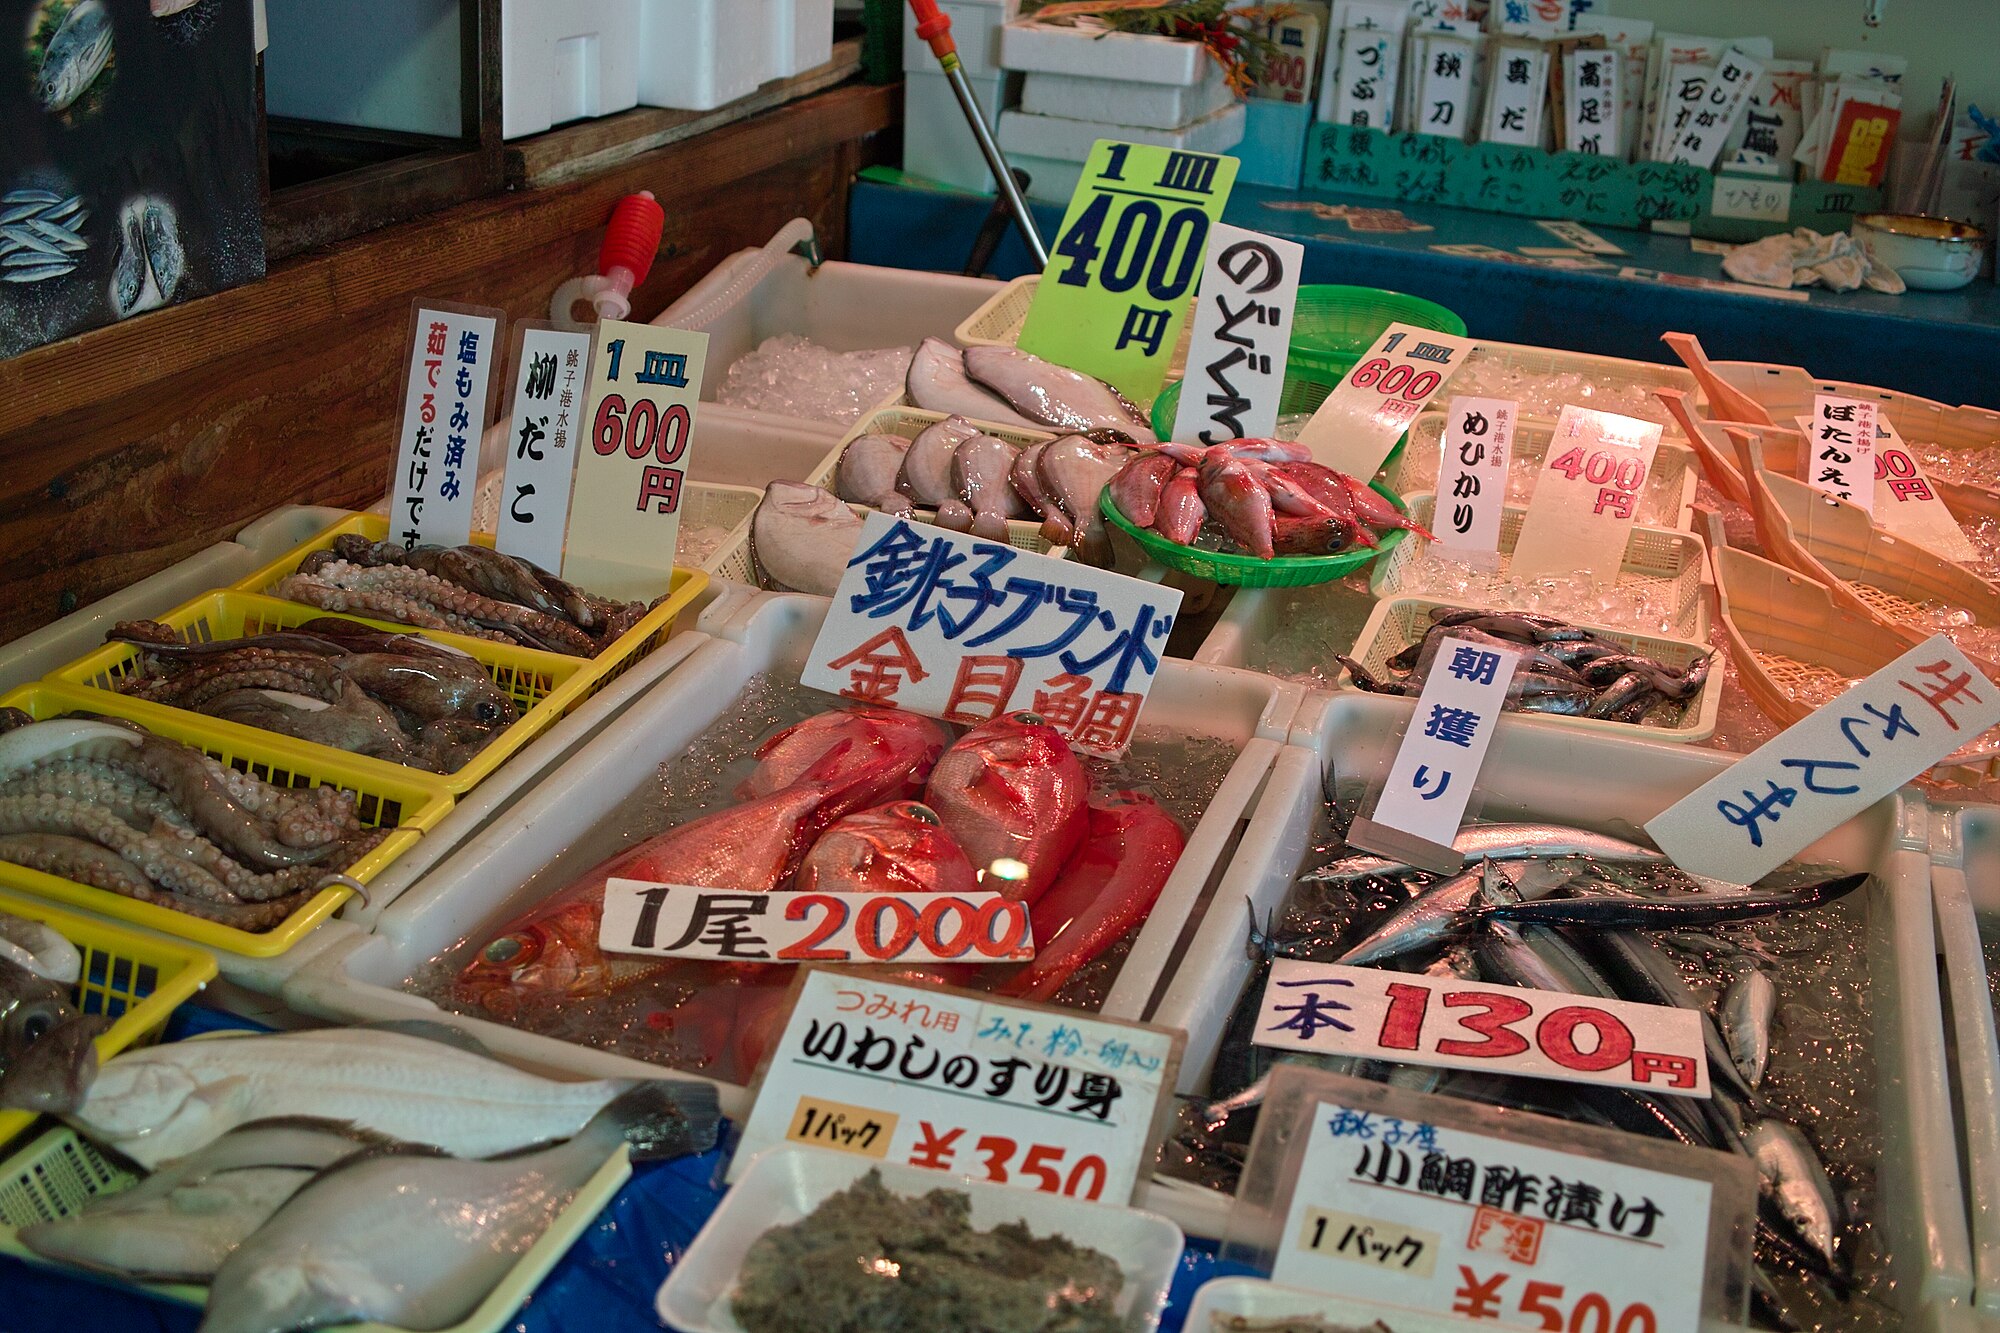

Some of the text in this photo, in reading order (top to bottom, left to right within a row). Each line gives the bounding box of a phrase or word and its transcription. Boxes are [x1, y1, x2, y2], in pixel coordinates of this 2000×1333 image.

[1097, 143, 1219, 195] 1皿
[1056, 194, 1209, 302] 400
[1115, 304, 1173, 358] 円
[1381, 332, 1455, 364] 1皿
[606, 338, 690, 388] 1皿
[1350, 357, 1442, 401] 600
[440, 330, 480, 502] 塩もみ済み
[554, 349, 579, 449] 銚子港水揚
[510, 351, 558, 524] 柳だこ
[591, 393, 691, 464] 600
[636, 465, 684, 514] 円
[1452, 411, 1489, 534] めひかり
[1550, 446, 1647, 491] 400
[1887, 477, 1934, 502] 円
[1594, 487, 1638, 519] 円
[847, 519, 1173, 695] 銚子ブランド
[827, 624, 1144, 752] 金目鯛
[1413, 645, 1502, 801] 朝獲り
[836, 989, 961, 1033] つみれ用
[801, 1018, 1123, 1121] いわしのすり身
[799, 1107, 883, 1150] 1パック
[1354, 1142, 1666, 1239] 小鯛酢漬け
[1310, 1217, 1425, 1268] 1パック
